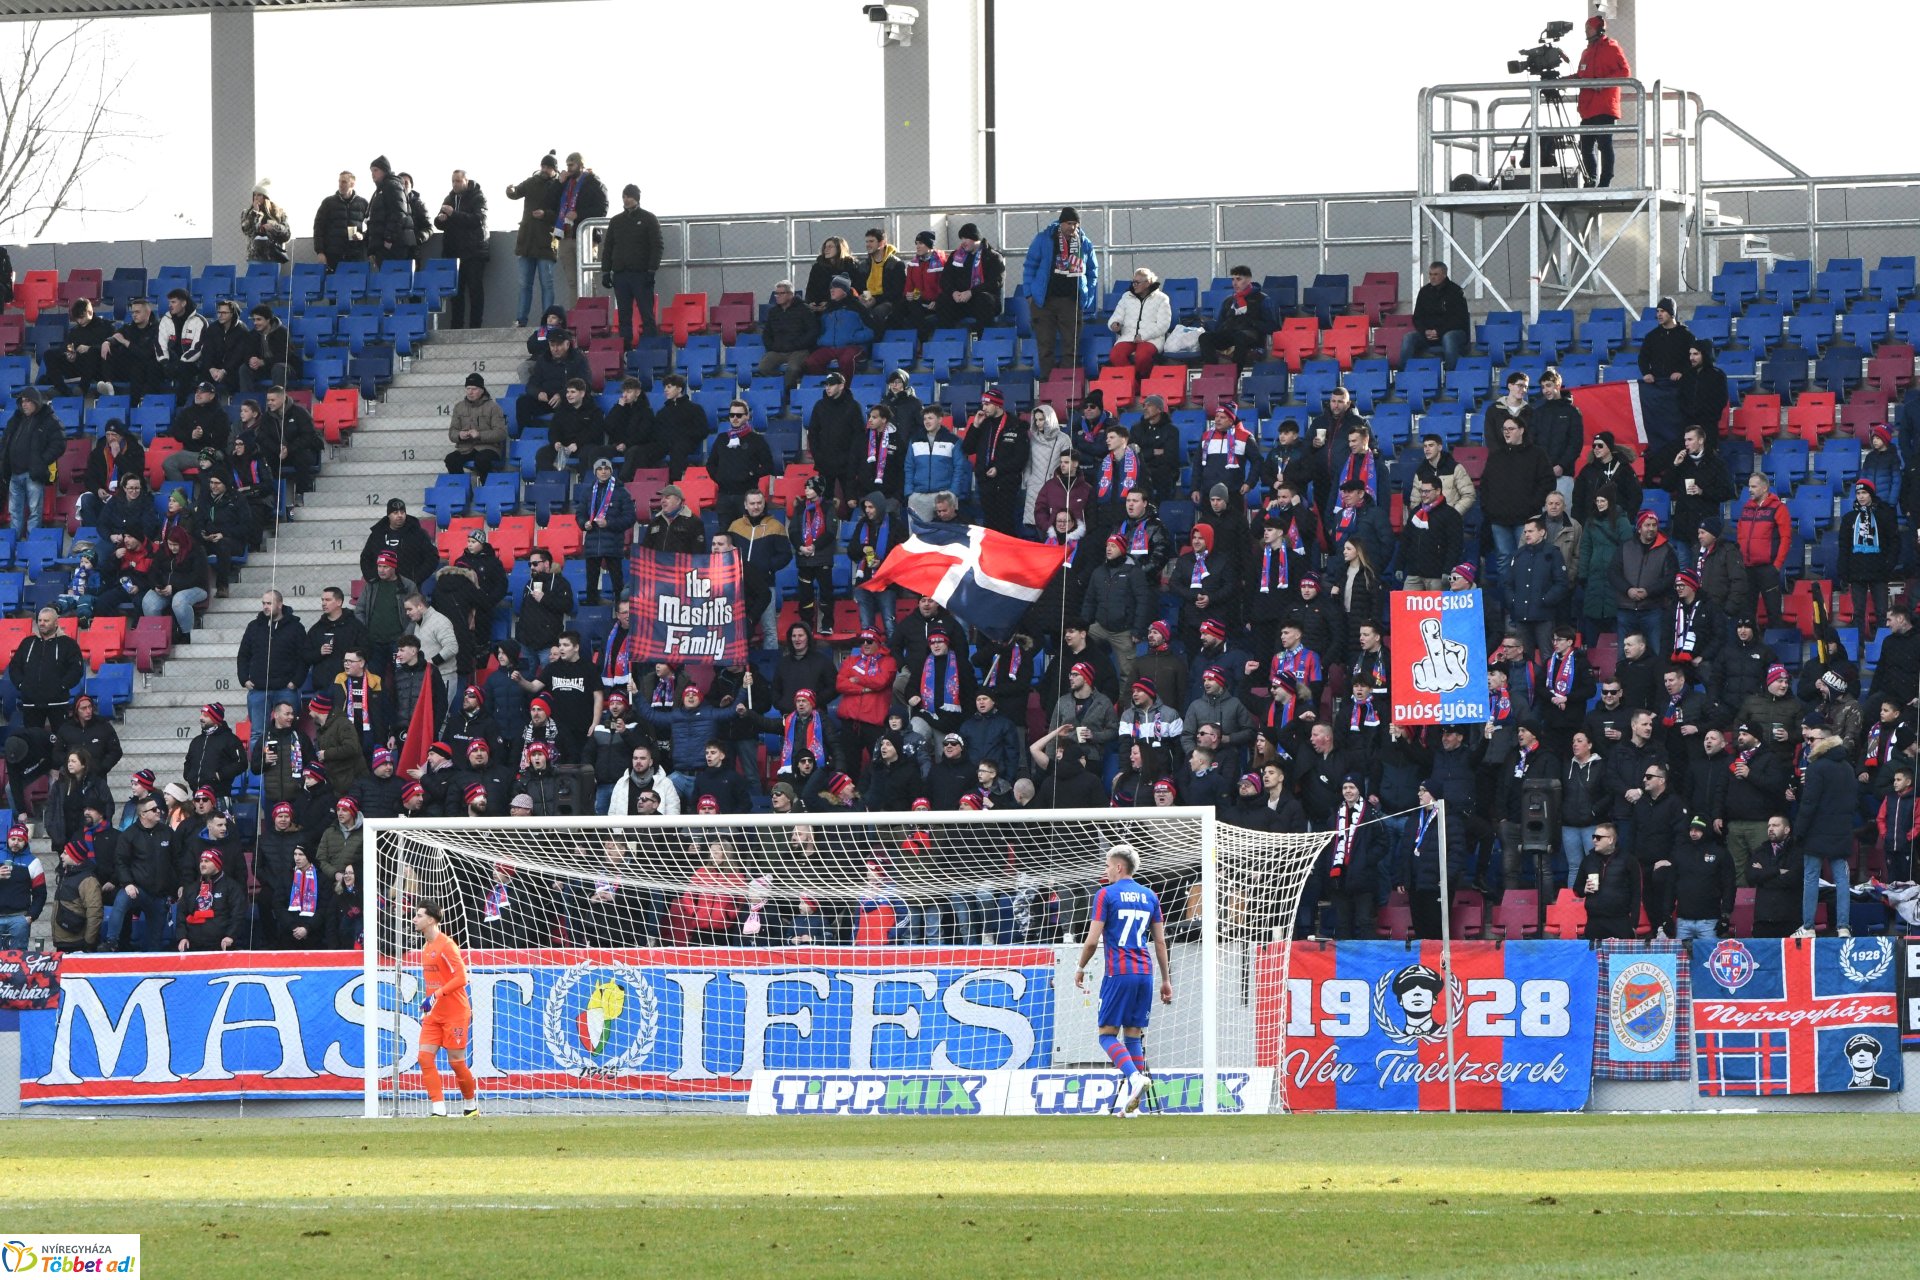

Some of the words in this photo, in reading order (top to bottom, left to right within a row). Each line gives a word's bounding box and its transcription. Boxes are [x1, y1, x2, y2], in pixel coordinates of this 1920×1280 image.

[472, 362, 485, 372] 15
[437, 405, 450, 416] 14
[402, 449, 415, 460] 13
[366, 494, 380, 505] 12
[330, 539, 342, 551] 11
[686, 569, 711, 598] the
[292, 585, 305, 596] 10
[1406, 593, 1474, 611] MOCSKOS
[658, 595, 732, 626] Mastiffs
[664, 625, 725, 661] Family
[215, 679, 230, 690] 08
[176, 726, 191, 738] 07
[1120, 891, 1140, 903] NAGY
[1117, 909, 1151, 947] 77
[1851, 950, 1880, 962] 1928
[26, 954, 58, 975] Fans
[1286, 978, 1371, 1038] 19
[1466, 978, 1571, 1038] 28
[1702, 1000, 1894, 1027] Nyíregyháza
[1282, 1046, 1358, 1089] Vén
[1375, 1047, 1571, 1089] Tinédzserek
